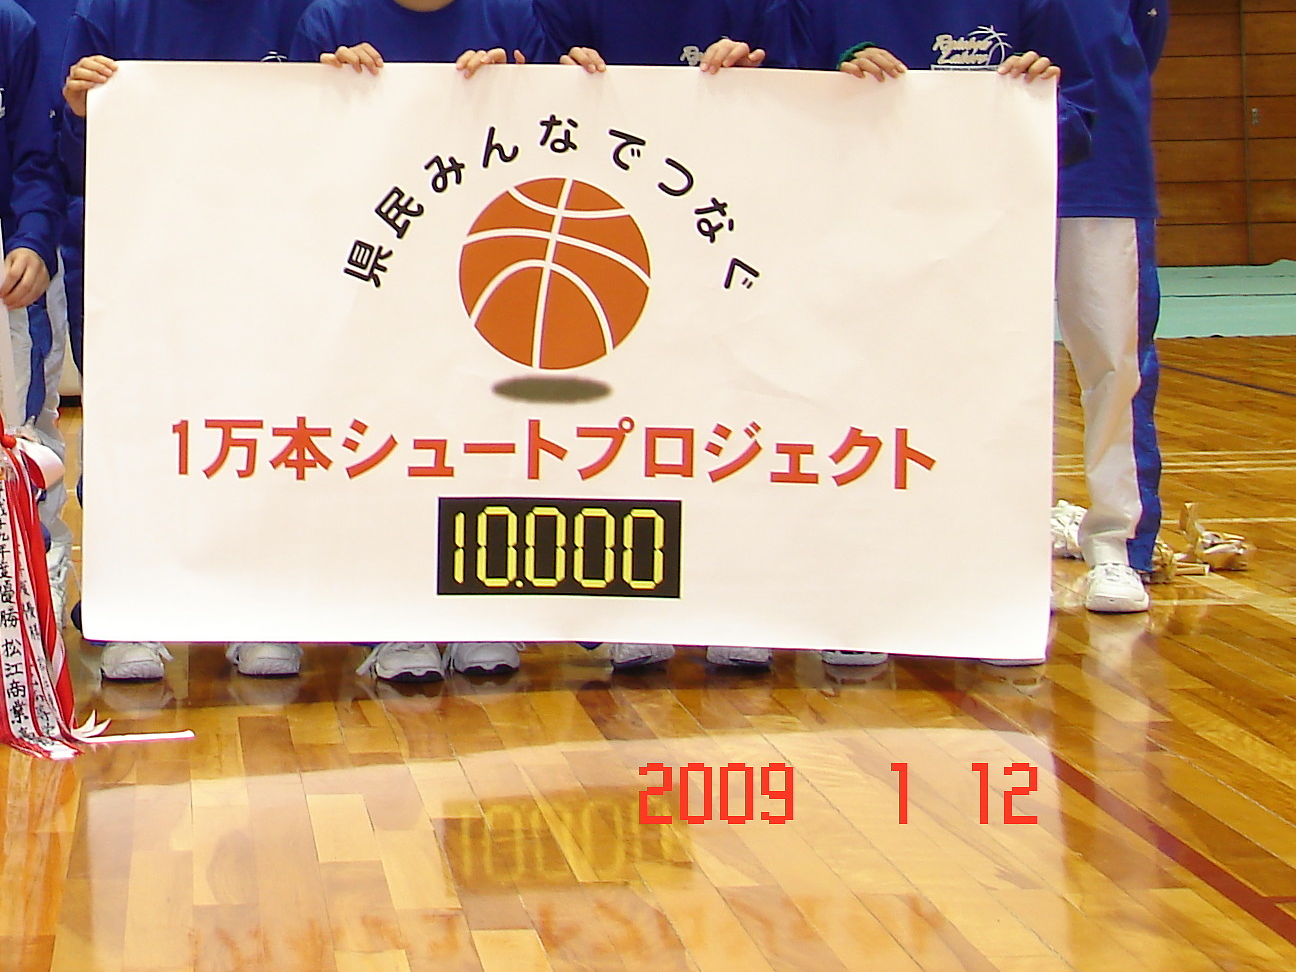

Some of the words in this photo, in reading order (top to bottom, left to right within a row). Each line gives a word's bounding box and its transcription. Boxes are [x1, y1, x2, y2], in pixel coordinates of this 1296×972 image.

[343, 113, 761, 294] 県民みんなでつなぐ
[171, 415, 936, 490] 1万本シュートプロジェクト
